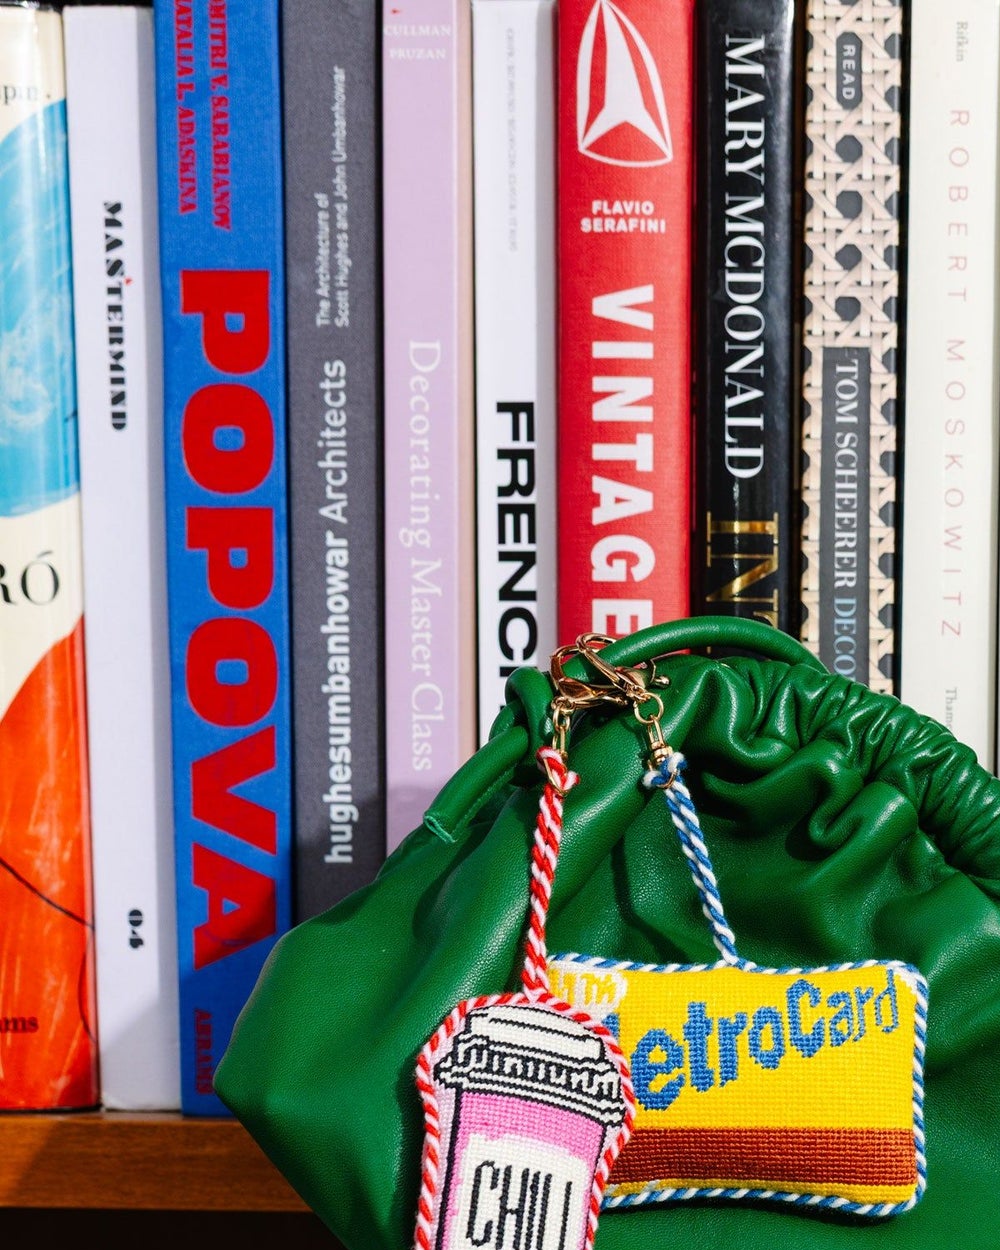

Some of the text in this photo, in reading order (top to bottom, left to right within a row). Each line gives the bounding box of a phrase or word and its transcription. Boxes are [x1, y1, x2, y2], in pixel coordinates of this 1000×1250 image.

[174, 0, 196, 77] ATALIA
[207, 0, 229, 69] MITRI
[383, 23, 452, 37] CULLMAN
[389, 47, 447, 60] PRUZAN
[841, 44, 856, 100] READ
[177, 105, 198, 215] ADASKINA
[211, 94, 232, 231] SARABIANOV
[330, 66, 351, 328] Scott Hughes and John Umbanhowar
[580, 217, 666, 234] SERAFINI
[591, 199, 655, 217] FLAVIO
[103, 200, 128, 432] MASTERMIND
[314, 192, 332, 328] The Architecture of
[723, 34, 766, 479] MARY MCDONALD
[941, 109, 971, 638] ROBERT MOSKOWITZ
[589, 284, 656, 637] VINTAGE
[832, 359, 859, 682] TOM SCHEERER DECO
[179, 269, 279, 971] POPOVA
[317, 358, 354, 864] hughesumbanhowar Architects
[399, 339, 445, 771] Decorating Master Class
[706, 511, 779, 629] IN
[603, 967, 900, 1111] etroCard
